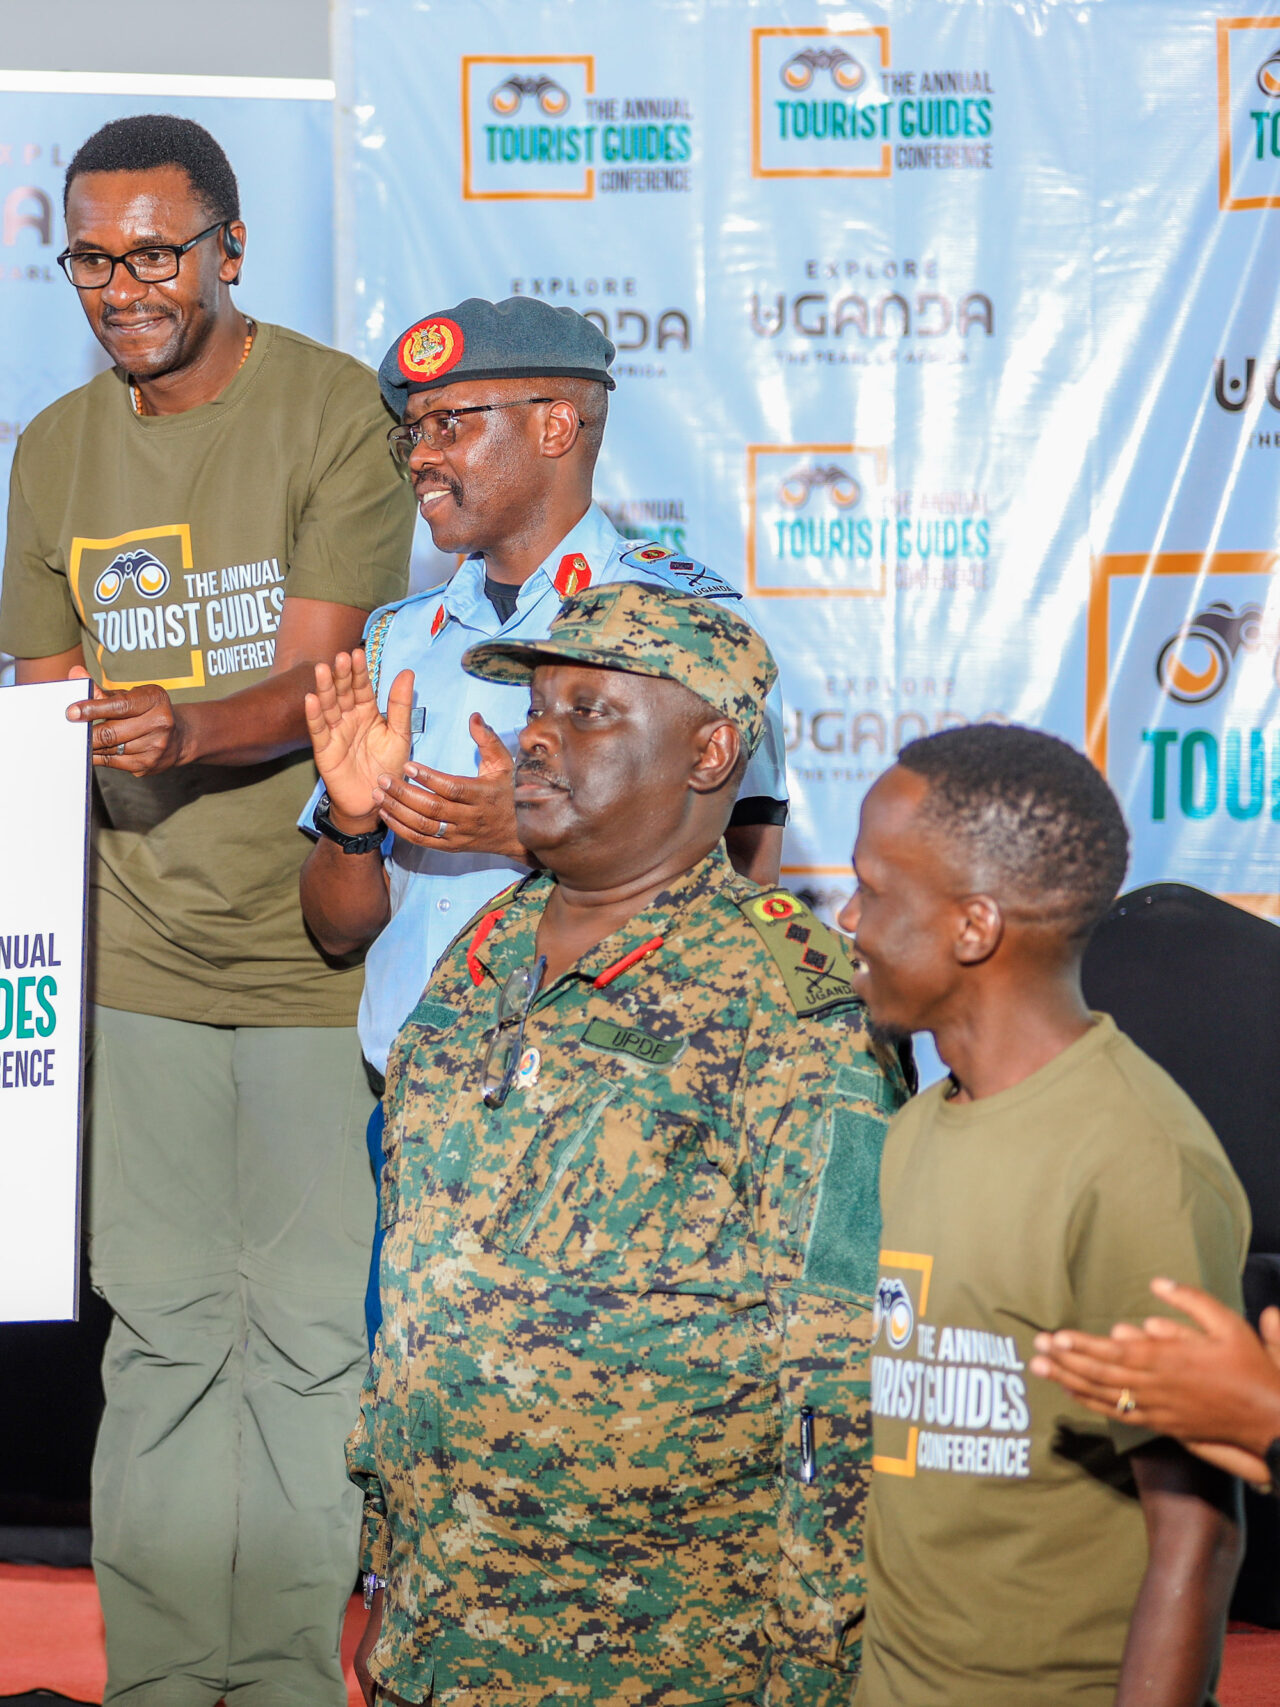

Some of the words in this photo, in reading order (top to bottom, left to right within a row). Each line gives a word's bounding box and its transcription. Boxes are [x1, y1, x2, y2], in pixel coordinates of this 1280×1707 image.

[881, 72, 916, 95] THE
[920, 71, 994, 94] ANNUAL
[585, 99, 618, 121] THE
[622, 98, 693, 121] ANNUAL
[776, 99, 894, 140] TOURIST
[900, 98, 993, 139] GUIDES
[484, 124, 597, 163] TOURIST
[603, 124, 692, 163] GUIDES
[599, 168, 692, 193] CONFERENCE
[806, 259, 938, 279] EXPLORE
[512, 277, 637, 297] EXPLORE
[751, 293, 995, 337] UGANDA
[775, 517, 889, 560] TOURIST
[897, 517, 991, 560] GUIDES
[184, 570, 220, 598] THE
[222, 558, 286, 594] ANNUAL
[693, 585, 733, 596] UGANDA
[92, 602, 201, 654] TOURIST
[206, 586, 286, 643] GUIDES
[826, 676, 956, 696] EXPLORE
[806, 985, 855, 1005] UGAND
[612, 1031, 667, 1060] UPDF
[937, 1326, 1025, 1371] ANNUAL
[924, 1364, 1030, 1432] GUIDES
[917, 1430, 1031, 1477] CONFERENCE
